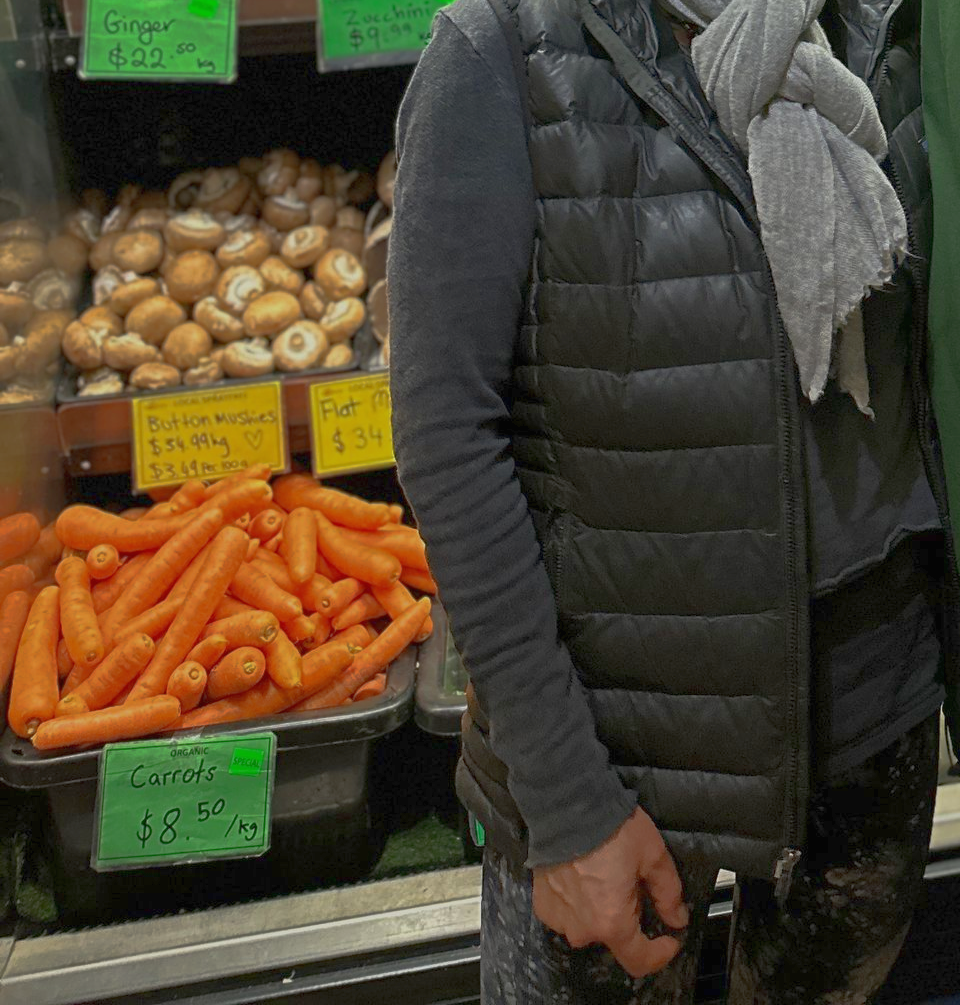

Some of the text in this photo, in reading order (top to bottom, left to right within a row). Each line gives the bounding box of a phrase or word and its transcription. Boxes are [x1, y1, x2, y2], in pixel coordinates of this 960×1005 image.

[342, 0, 432, 27] Zucchini
[104, 9, 177, 45] Ginger
[197, 57, 217, 74] kg
[320, 395, 363, 421] Flat
[147, 412, 211, 433] Button
[170, 747, 209, 758] ORGANIC
[233, 757, 260, 768] SPECIAL
[130, 759, 218, 789] Carrots
